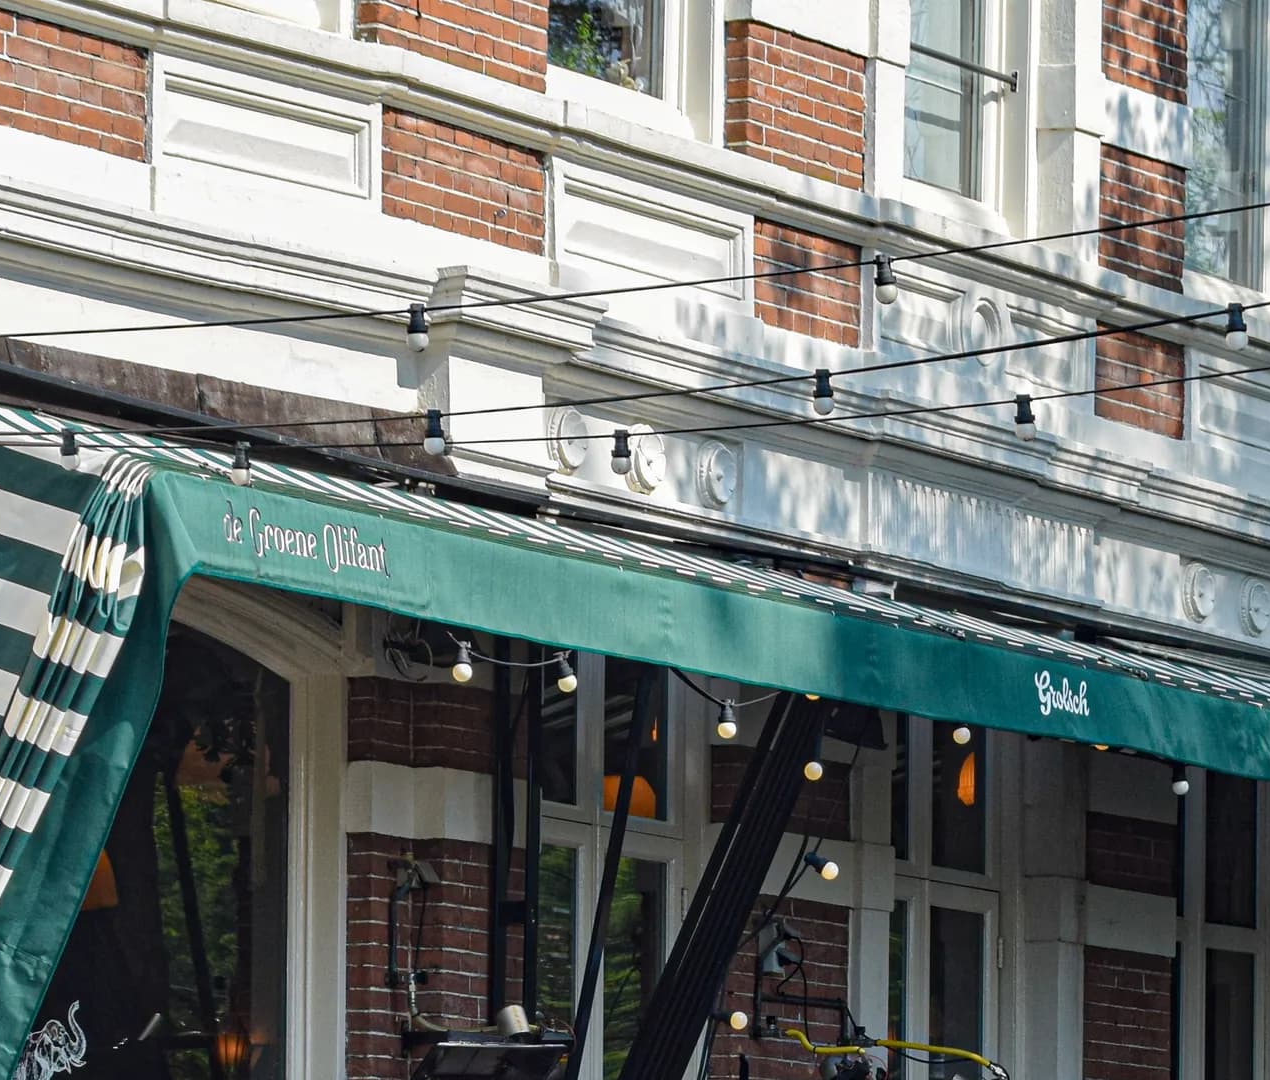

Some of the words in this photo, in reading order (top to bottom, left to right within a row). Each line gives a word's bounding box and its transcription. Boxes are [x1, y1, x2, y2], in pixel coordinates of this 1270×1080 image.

[223, 499, 244, 544] de
[248, 506, 318, 558] Groene
[323, 523, 391, 579] Olifant
[1034, 670, 1090, 717] Grolsch
